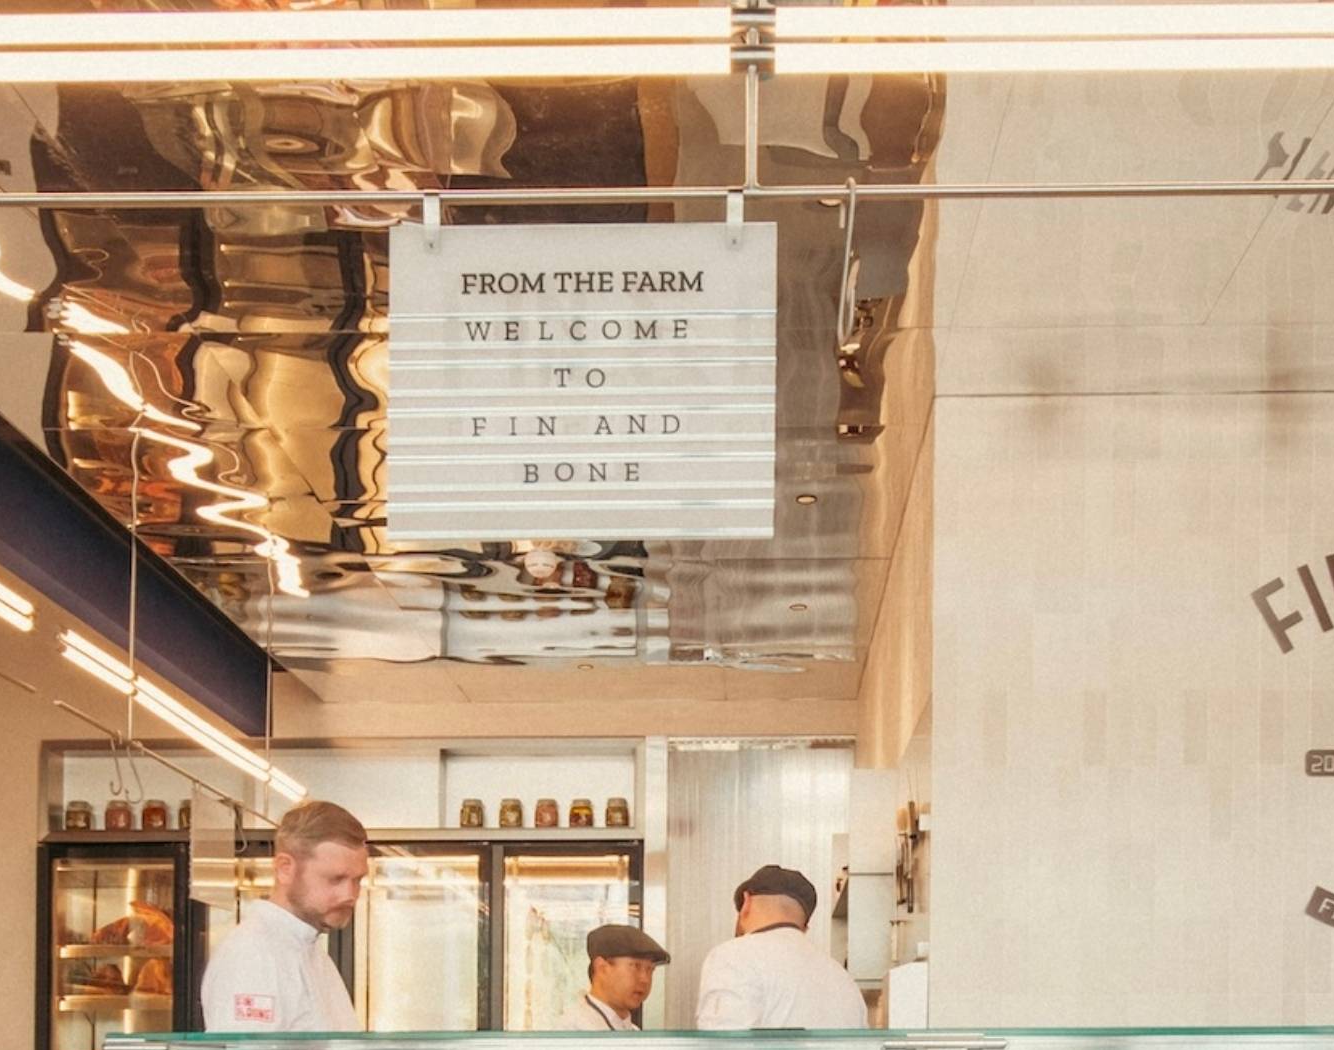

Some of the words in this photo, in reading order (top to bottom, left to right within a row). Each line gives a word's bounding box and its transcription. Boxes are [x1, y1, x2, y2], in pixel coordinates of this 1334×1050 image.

[461, 272, 546, 295] FROM
[553, 271, 614, 294] THE
[621, 270, 704, 293] FARM
[465, 318, 689, 342] WELCOME
[553, 367, 606, 389] TO
[471, 416, 557, 437] FIN
[594, 414, 681, 436] AND
[523, 462, 641, 484] BONE
